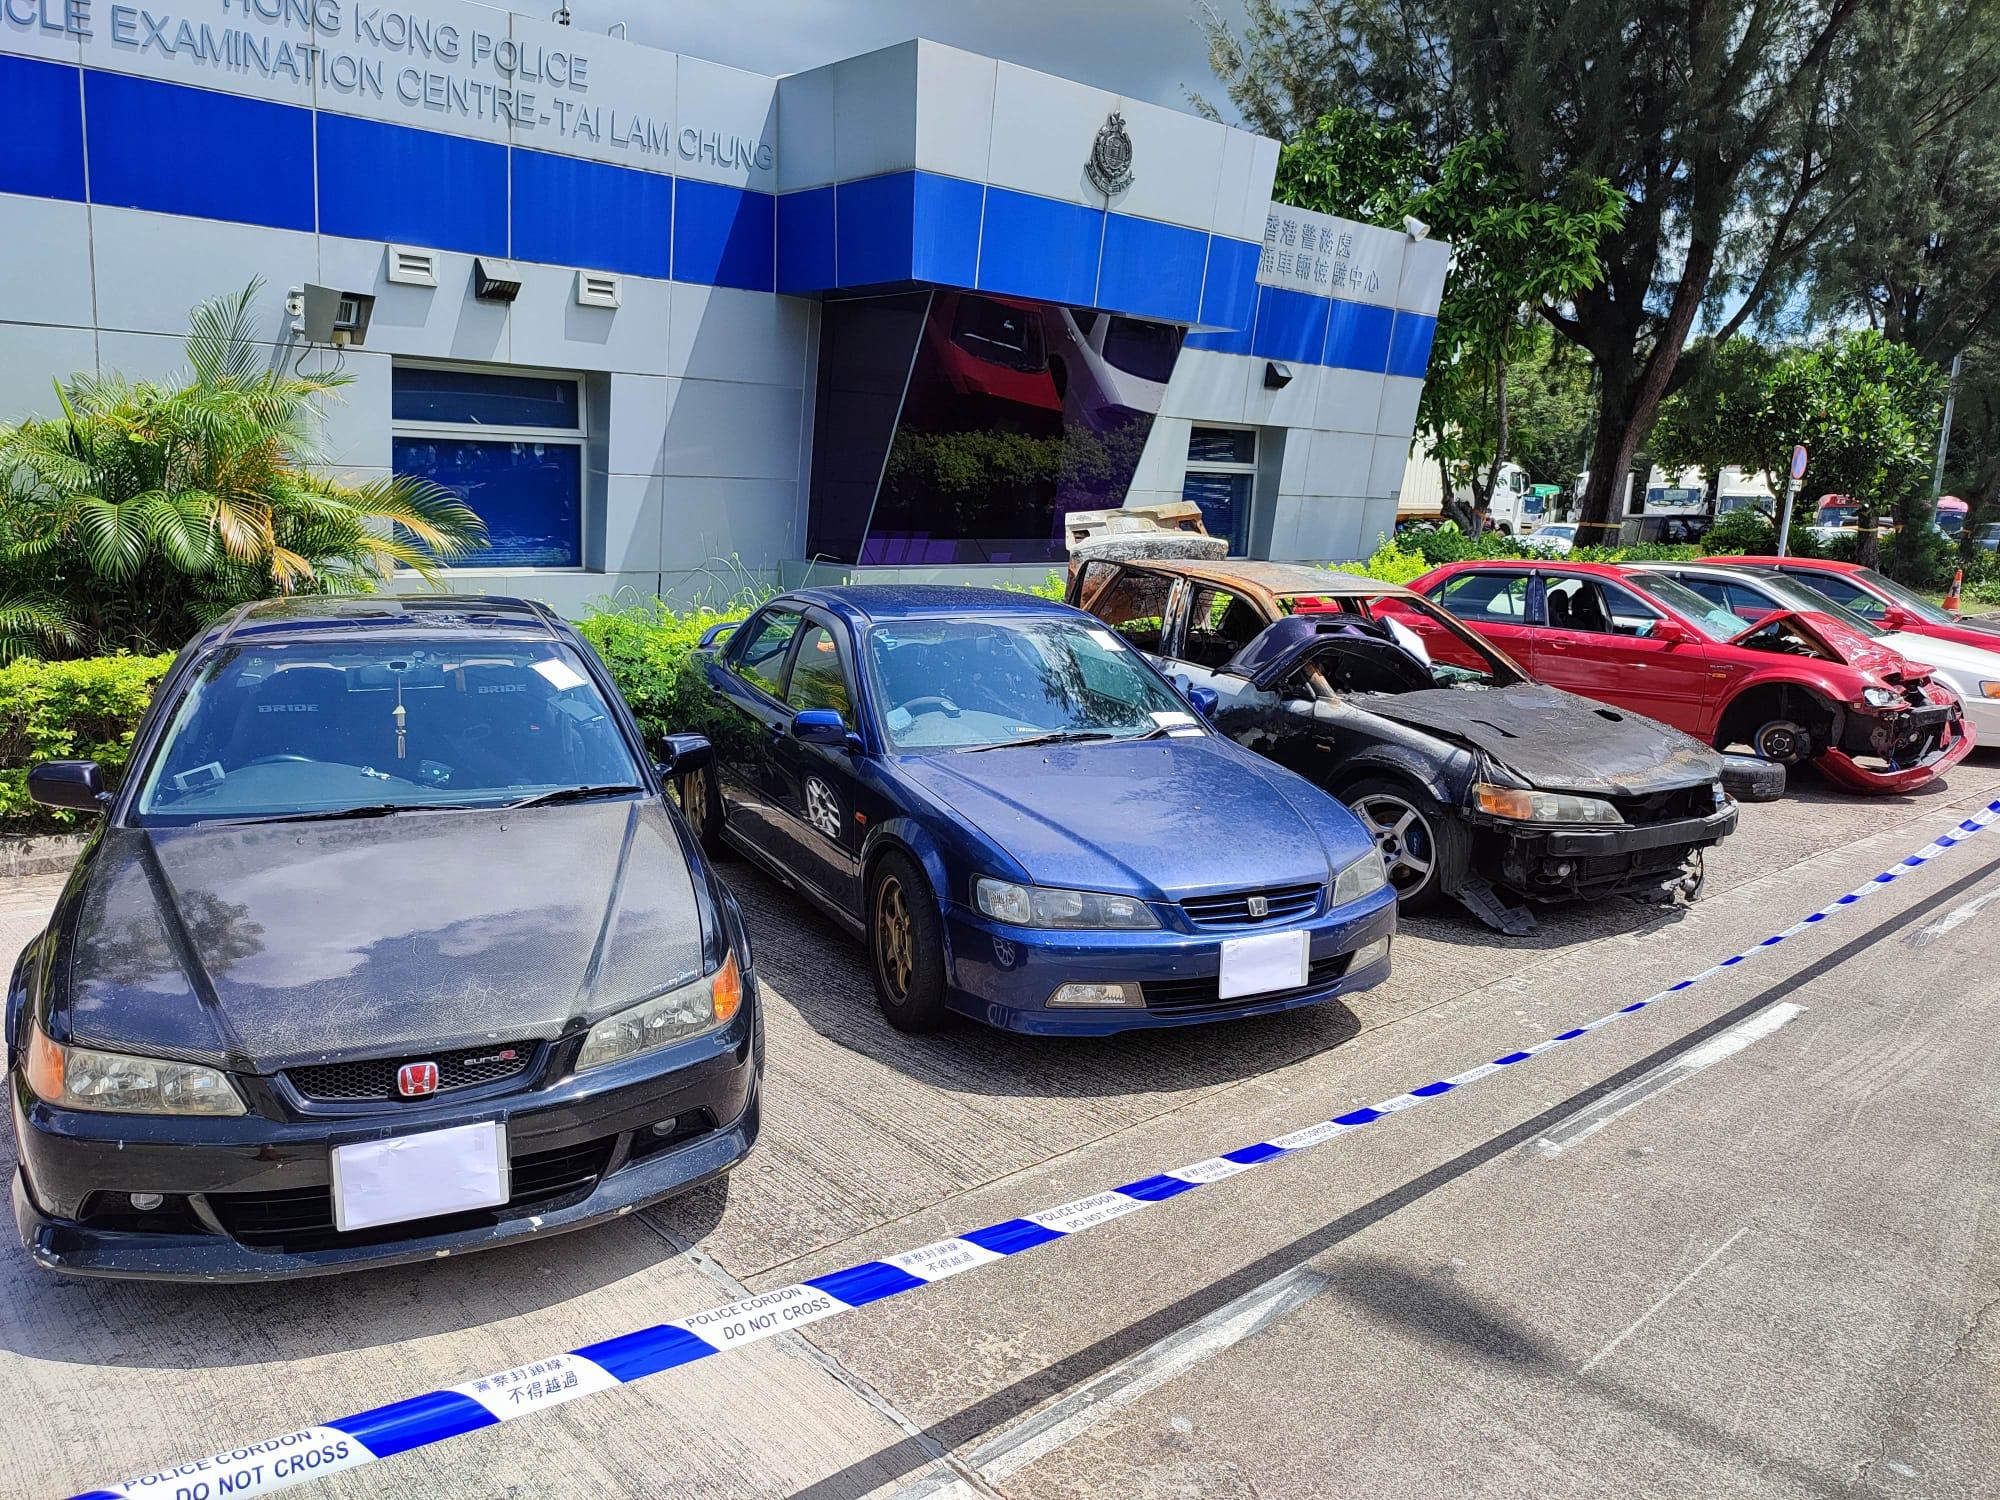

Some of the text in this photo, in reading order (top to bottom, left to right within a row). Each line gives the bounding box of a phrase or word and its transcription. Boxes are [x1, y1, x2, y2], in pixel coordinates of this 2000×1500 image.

[354, 2, 461, 58] KONG
[472, 29, 590, 88] POLICE
[111, 4, 385, 94] EXAMINATION
[397, 66, 601, 138] CENTRE-TAI
[610, 108, 670, 153] LAM
[677, 128, 775, 172] CHUNG
[478, 684, 528, 695] BRIDE
[257, 703, 320, 713] BRIDE
[1035, 1206, 1076, 1224] POLICE
[1066, 1200, 1142, 1230] DO NOT CROSS
[684, 1305, 742, 1329] POLICE
[722, 1297, 832, 1341] DO NOT CROSS
[506, 1370, 580, 1405] 不得越過
[122, 1460, 213, 1493] POLICE
[175, 1441, 351, 1500] DO NOT CROSS
